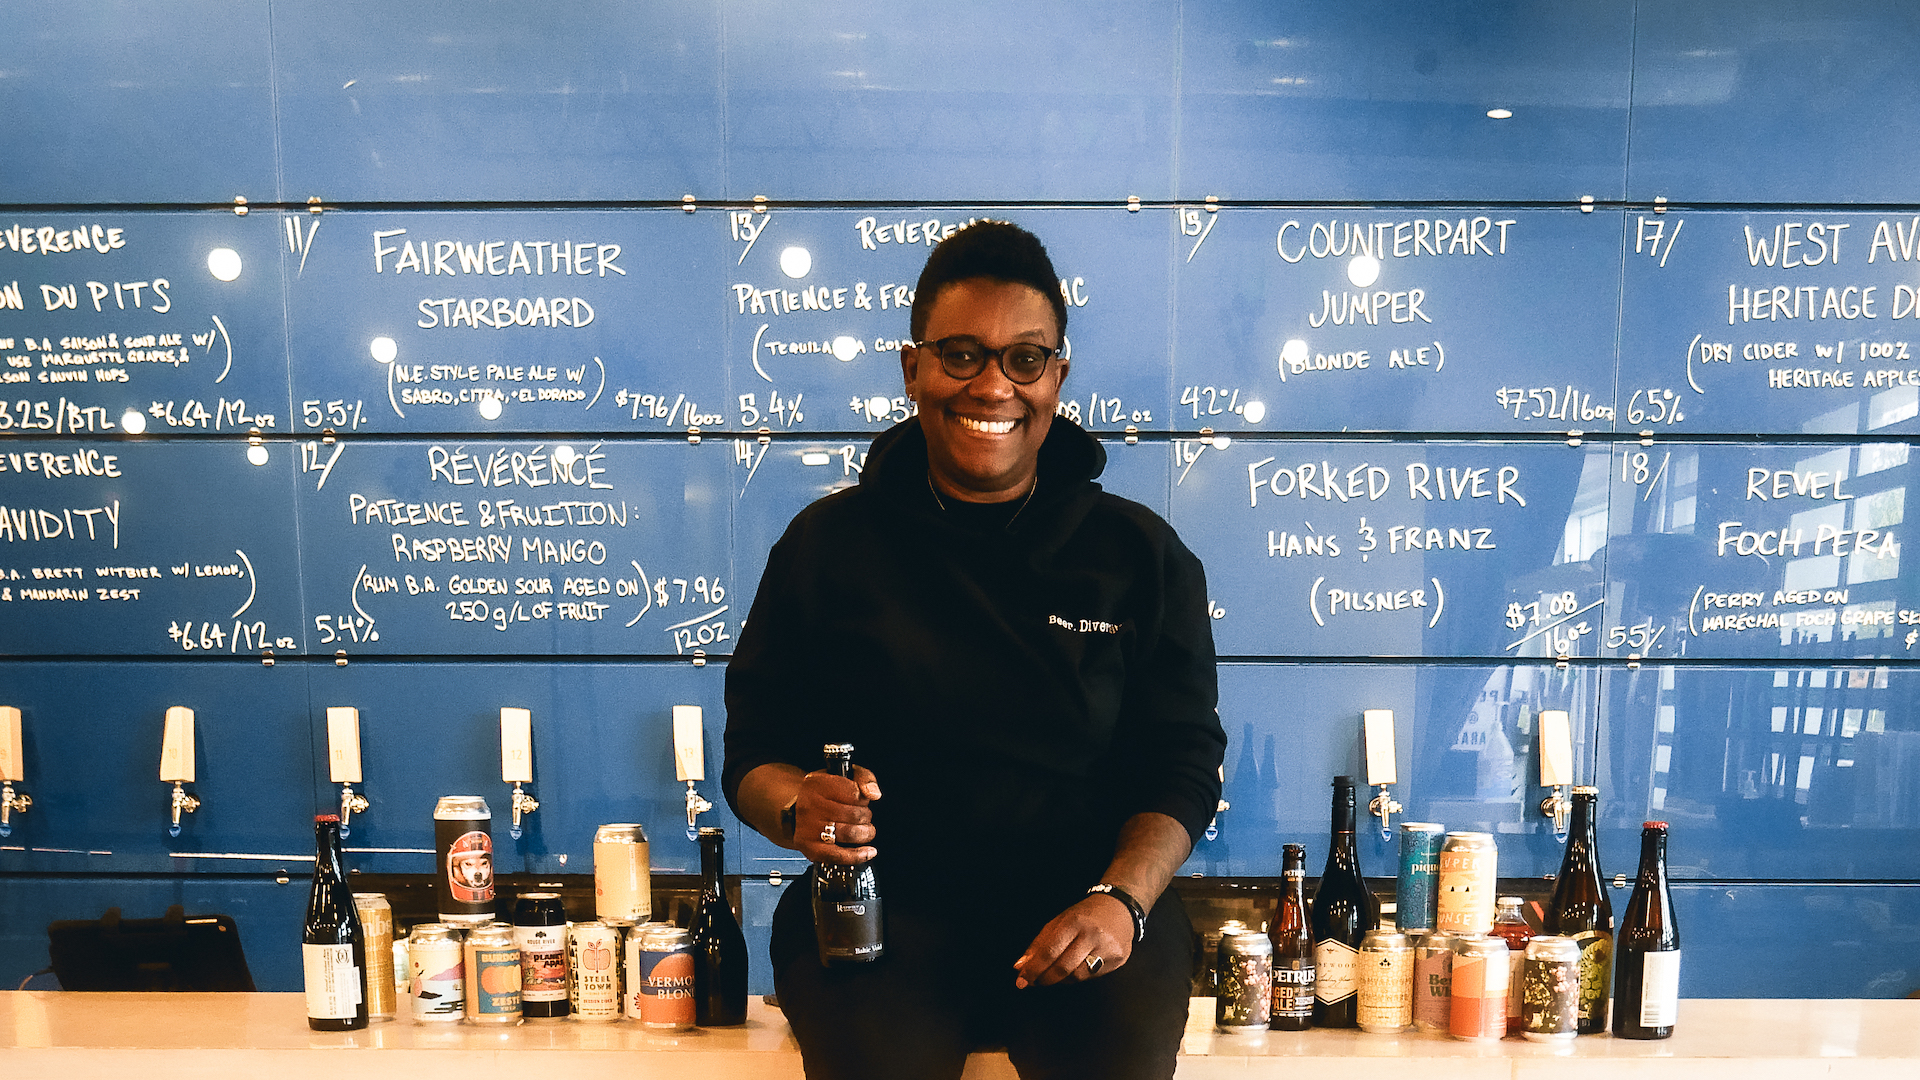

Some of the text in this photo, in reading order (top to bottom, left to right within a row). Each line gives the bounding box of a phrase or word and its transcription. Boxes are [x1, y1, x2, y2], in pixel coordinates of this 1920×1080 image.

[284, 212, 320, 273] 11/
[729, 210, 771, 266] 13/
[854, 216, 1010, 251] REVERE
[1175, 207, 1219, 264] 15/
[1276, 216, 1517, 265] COUNTERPART
[1635, 215, 1684, 268] 17/
[1744, 222, 1851, 269] WEST
[373, 228, 627, 277] FAIRWEATHER
[39, 284, 78, 311] DU
[85, 278, 171, 314] PITS
[417, 296, 595, 330] STARBOARD
[731, 283, 848, 316] PATIENCE
[854, 281, 873, 311] &
[1308, 286, 1433, 328] JUMPER
[1728, 283, 1878, 325] HERITAGE
[123, 334, 156, 349] SOUR
[1700, 342, 1733, 364] DRY
[1743, 341, 1799, 361] CIDER
[1859, 341, 1911, 361] 100%
[6, 355, 32, 369] USE
[429, 364, 480, 382] STYLE
[486, 363, 524, 382] PALE
[527, 364, 558, 382] ALE
[1768, 367, 1855, 389] HERITAGE
[302, 399, 367, 433] 5.5%
[738, 390, 804, 429] 5.4%
[300, 439, 346, 491] 12/
[733, 437, 770, 498] 14/
[1174, 440, 1208, 487] 16/
[1622, 450, 1671, 502] 18/
[1247, 456, 1527, 508] FORKED RIVER
[1746, 468, 1854, 501] REVEL
[0, 499, 120, 549] AVIDITY
[349, 493, 470, 527] PATIENCE
[478, 499, 496, 528] &
[391, 533, 607, 566] RASPBERRY MANGO
[1387, 526, 1496, 554] FRANZ
[1717, 522, 1897, 560] FOCH PERA
[31, 567, 83, 580] BRETT
[95, 566, 162, 579] WITBIER
[195, 564, 244, 579] LEMON,
[448, 574, 508, 595] GOLDEN
[514, 577, 554, 595] SOUR
[562, 577, 611, 597] AGED
[1, 587, 141, 602] & MANDARIN ZEST
[531, 601, 553, 620] OF
[556, 601, 610, 621] FRUIT
[1703, 588, 1850, 611] PERRY AGED ON
[1048, 614, 1122, 635] Beer. Diver
[1796, 610, 1837, 627] FOCH
[1840, 609, 1896, 626] GRAPE
[1898, 608, 1920, 626] SK
[1440, 857, 1481, 871] UPER
[584, 983, 612, 991] TOWN
[648, 975, 695, 988] VERMO
[1272, 986, 1294, 999] GED
[1273, 969, 1317, 986] PETRUS
[1271, 998, 1294, 1011] ALE
